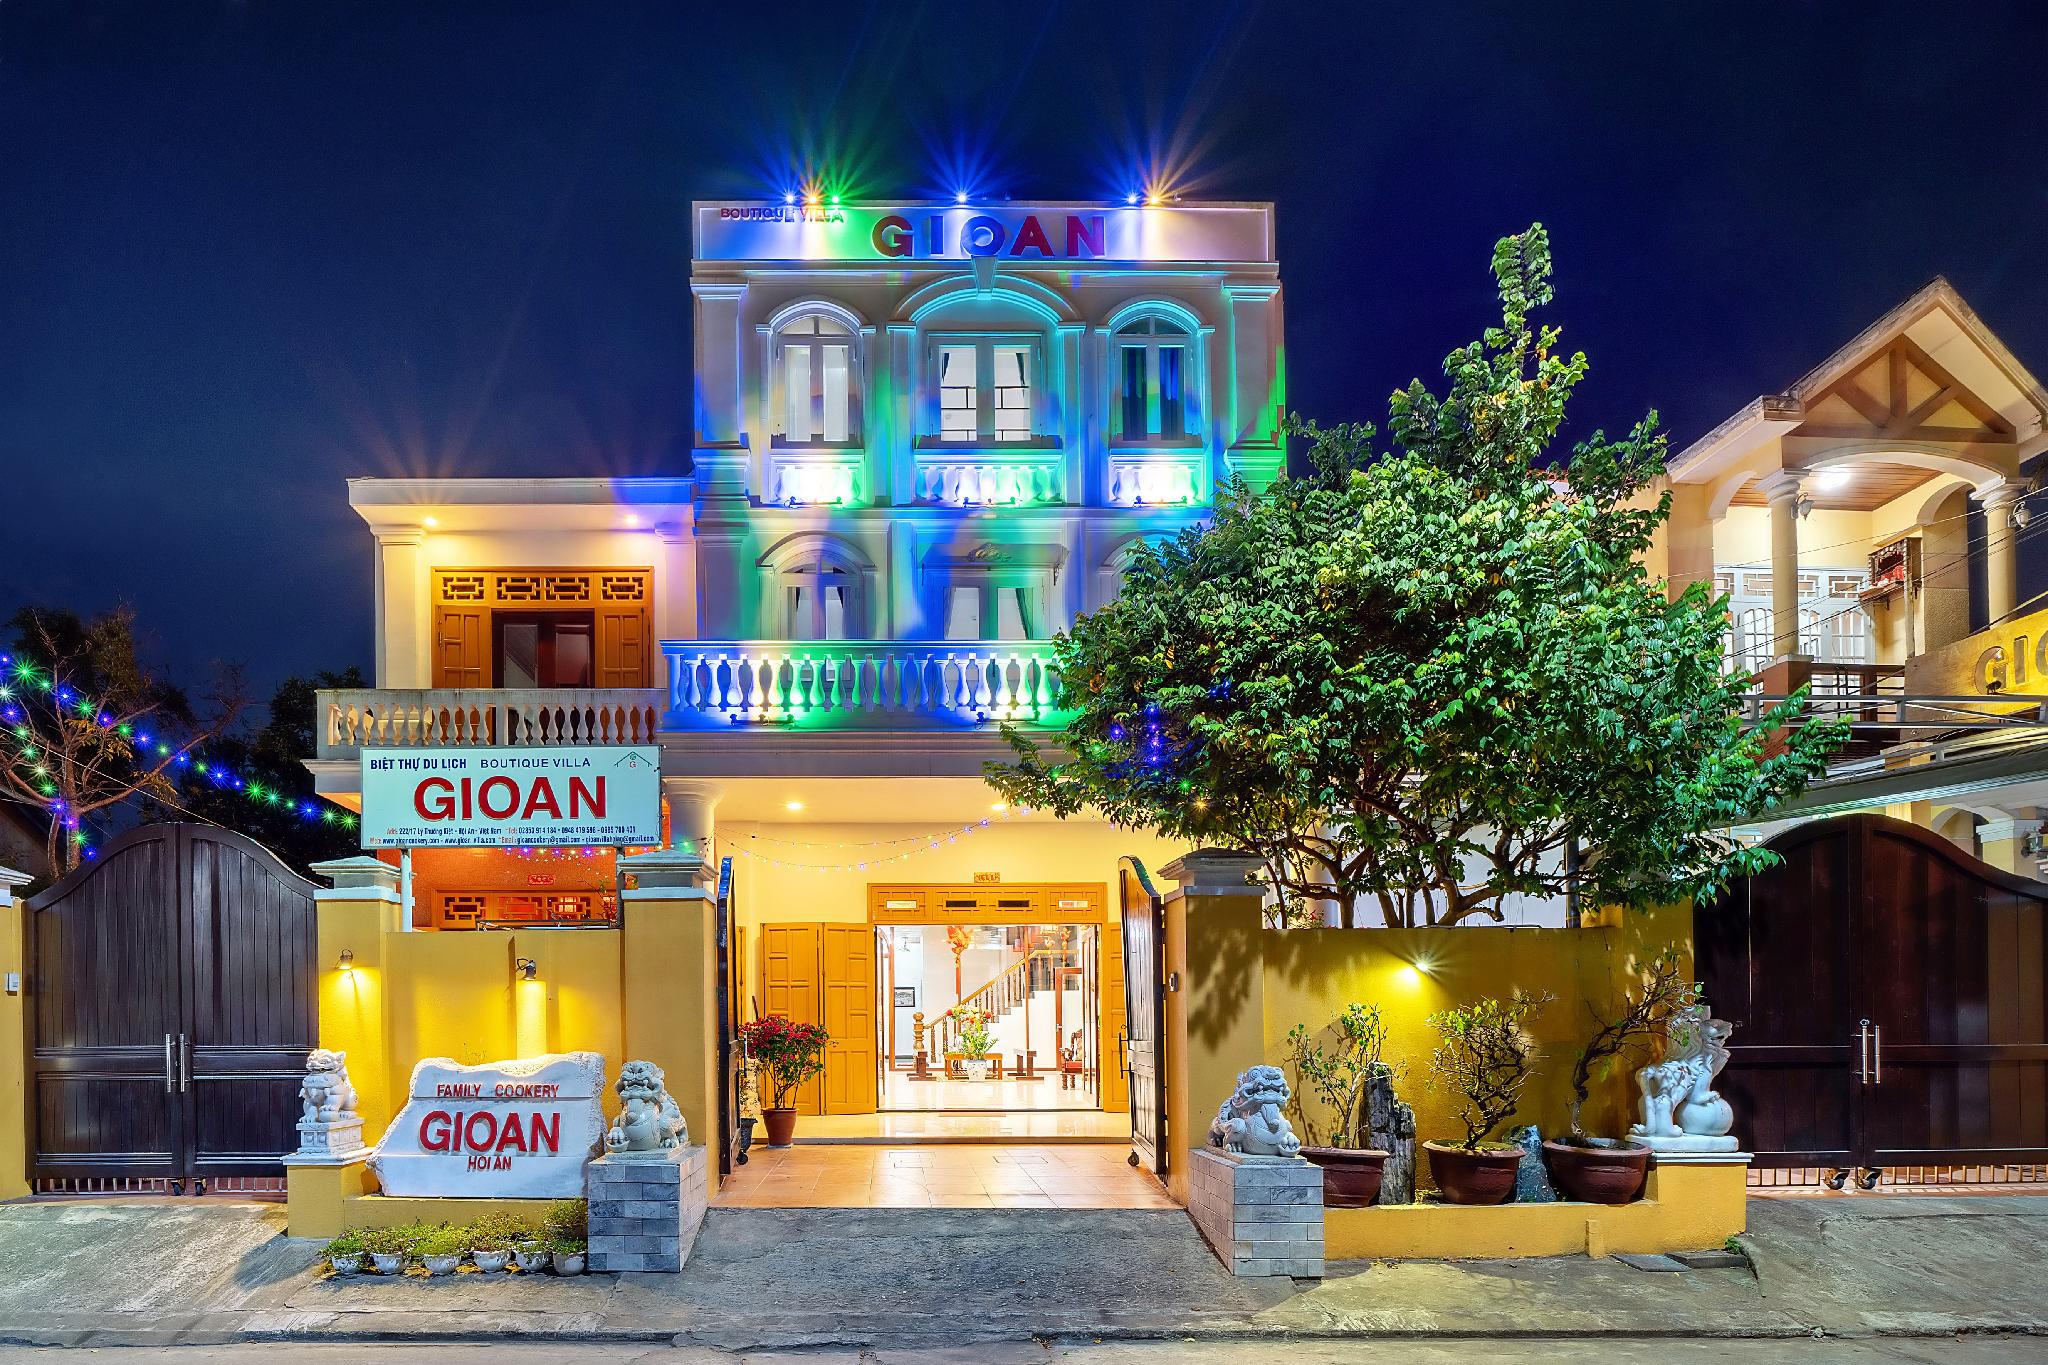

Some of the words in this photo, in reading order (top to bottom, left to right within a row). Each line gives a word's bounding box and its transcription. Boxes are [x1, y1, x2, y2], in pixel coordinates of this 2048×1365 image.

[720, 207, 795, 222] BOUTIQUE
[799, 208, 844, 222] VILLA
[872, 214, 1106, 257] GIOAN
[370, 757, 396, 772] BIỆT
[397, 757, 421, 772] THỰ
[423, 758, 439, 770] DU
[442, 758, 467, 771] LỊCH
[481, 758, 549, 769] BOUTIQUE
[552, 758, 591, 768] VILLA
[413, 775, 606, 821] GIOAN
[436, 1083, 482, 1098] FAMILY
[495, 1083, 560, 1098] COOKERY
[419, 1110, 560, 1153] GIOAN
[494, 1156, 511, 1170] AN
